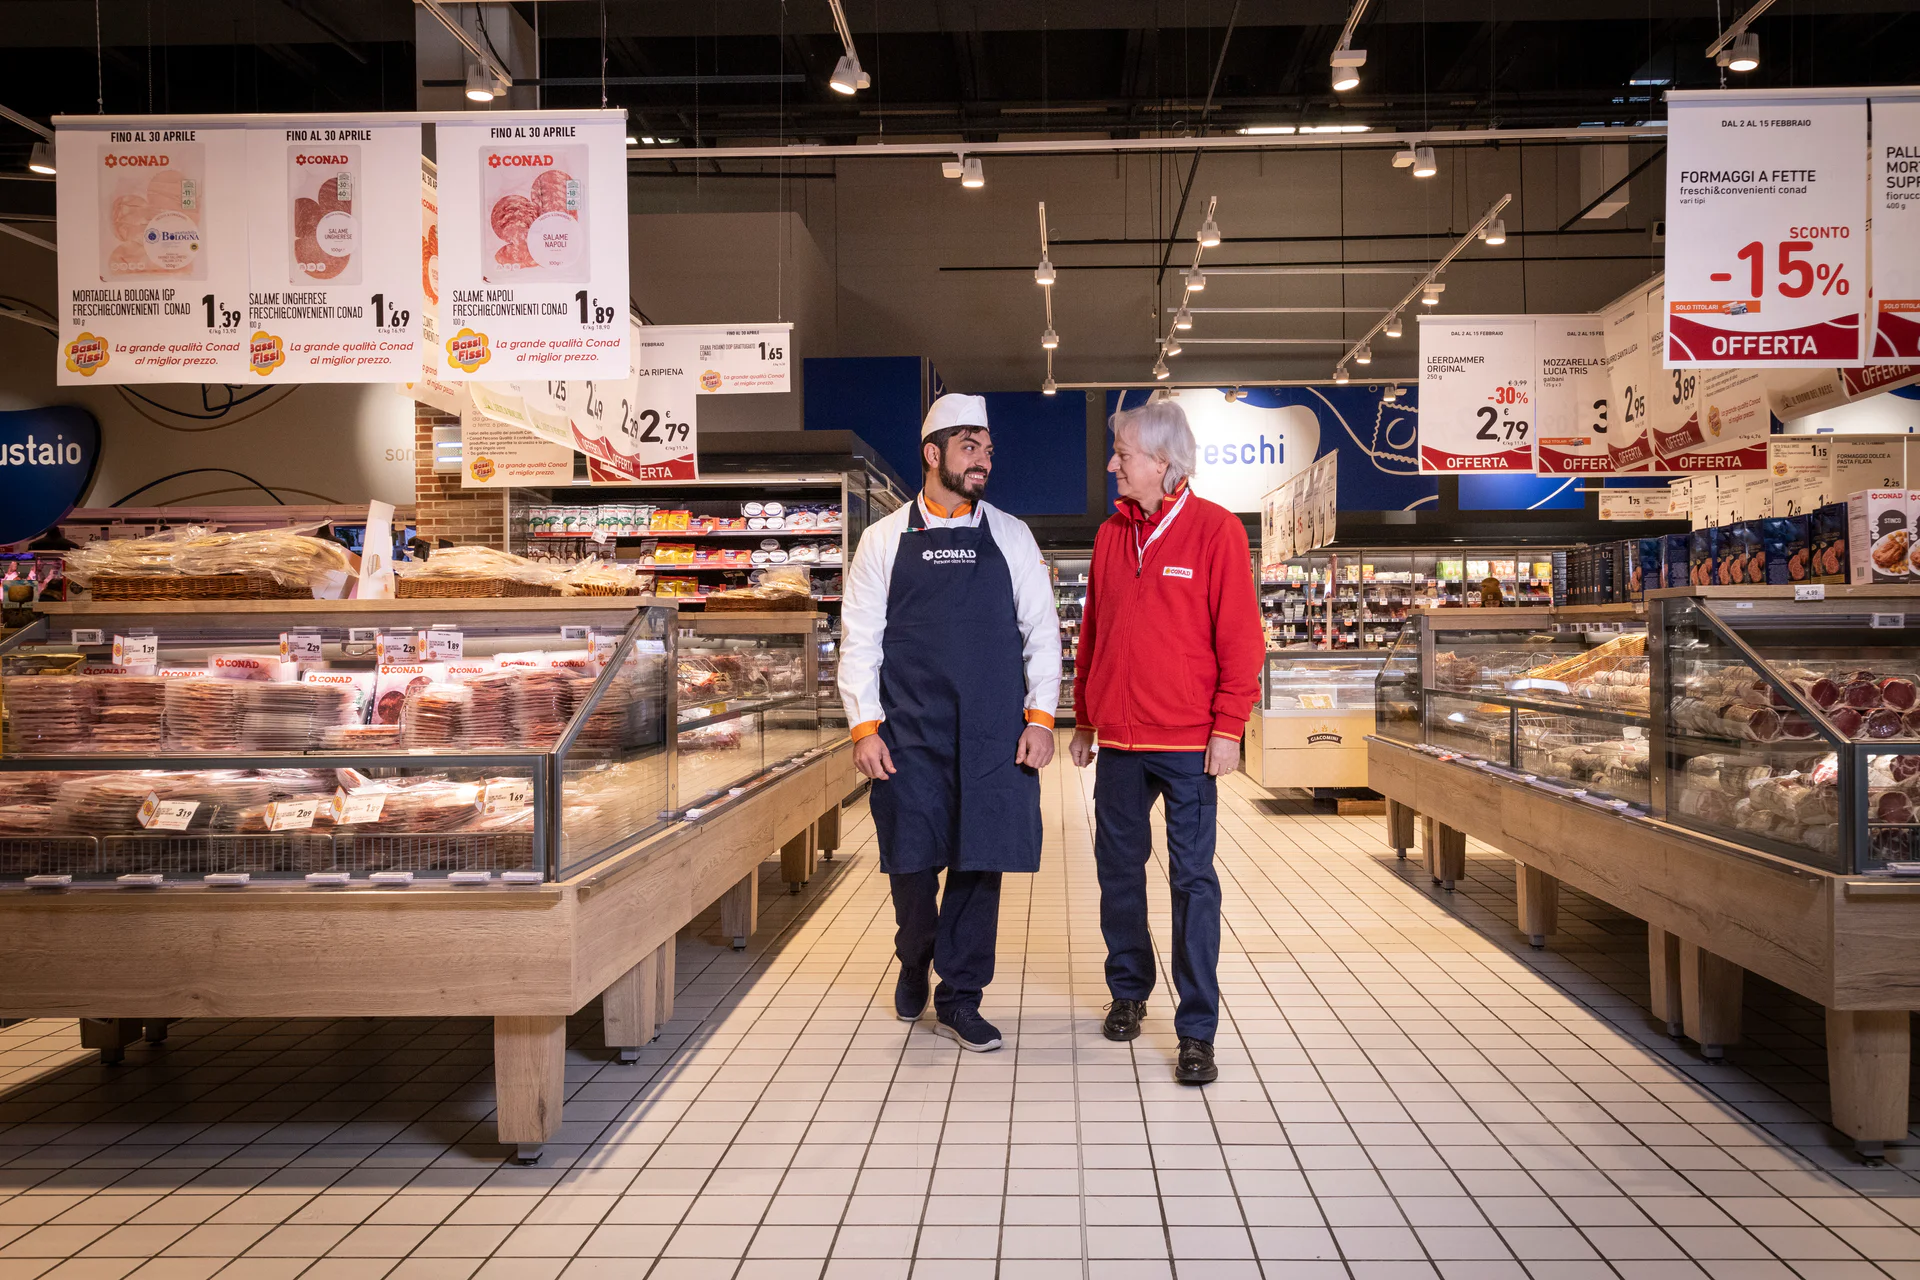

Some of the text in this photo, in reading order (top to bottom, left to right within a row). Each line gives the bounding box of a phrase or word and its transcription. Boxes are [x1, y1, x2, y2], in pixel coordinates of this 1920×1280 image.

[1771, 119, 1811, 127] FEBBRAIO
[111, 131, 196, 142] FINO AL 30 APRILE
[286, 130, 371, 141] FINO AL 30 APRILE
[491, 127, 576, 138] FINO AL 30 APRILE
[118, 155, 170, 167] CONAD
[307, 155, 349, 165] CONAD
[502, 155, 554, 167] CONAD
[1680, 170, 1816, 183] FORMAGGI A FETTE
[1680, 185, 1807, 195] freschi&convenienti conad
[1694, 197, 1706, 205] tipi
[1790, 226, 1850, 239] SCONTO
[1710, 241, 1850, 298] -15%
[73, 289, 176, 302] MORTADELLA BOLOGNA IGP
[249, 292, 327, 305] SALAME UNGHERESE
[453, 290, 514, 302] SALAME NAPOLI
[73, 302, 191, 317] FRESCHI&CONVENIENTI CONAD
[249, 306, 363, 319] FRESCHI&CONVENIENTI CONAD
[453, 303, 568, 316] FRESCHI&CONVENIENTI CONAD
[115, 342, 240, 354] La grande qualità Conad
[290, 341, 413, 353] La grande qualità Conad
[496, 338, 620, 350] La grande qualità Conad
[1712, 336, 1818, 356] OFFERTA
[135, 357, 218, 367] al miglior prezzo.
[310, 356, 392, 366] al miglior prezzo.
[516, 352, 599, 363] al miglior prezzo.
[1427, 356, 1484, 364] LEERDAMMER
[1543, 358, 1598, 367] MOZZARELLA
[652, 368, 683, 376] RIPIENA
[1427, 365, 1466, 373] ORIGINAL
[1543, 367, 1588, 375] LUCIA TRIS
[1862, 365, 1911, 386] OFFERTA
[1487, 386, 1528, 404] -30%
[1666, 431, 1693, 449] OFFERTA
[1618, 447, 1643, 463] OFFERTA
[613, 455, 634, 473] OFFERTA
[1447, 458, 1508, 468] OFFERTA
[1680, 456, 1742, 468] OFFERTA
[934, 550, 977, 559] CONAD
[225, 659, 259, 669] CONAD
